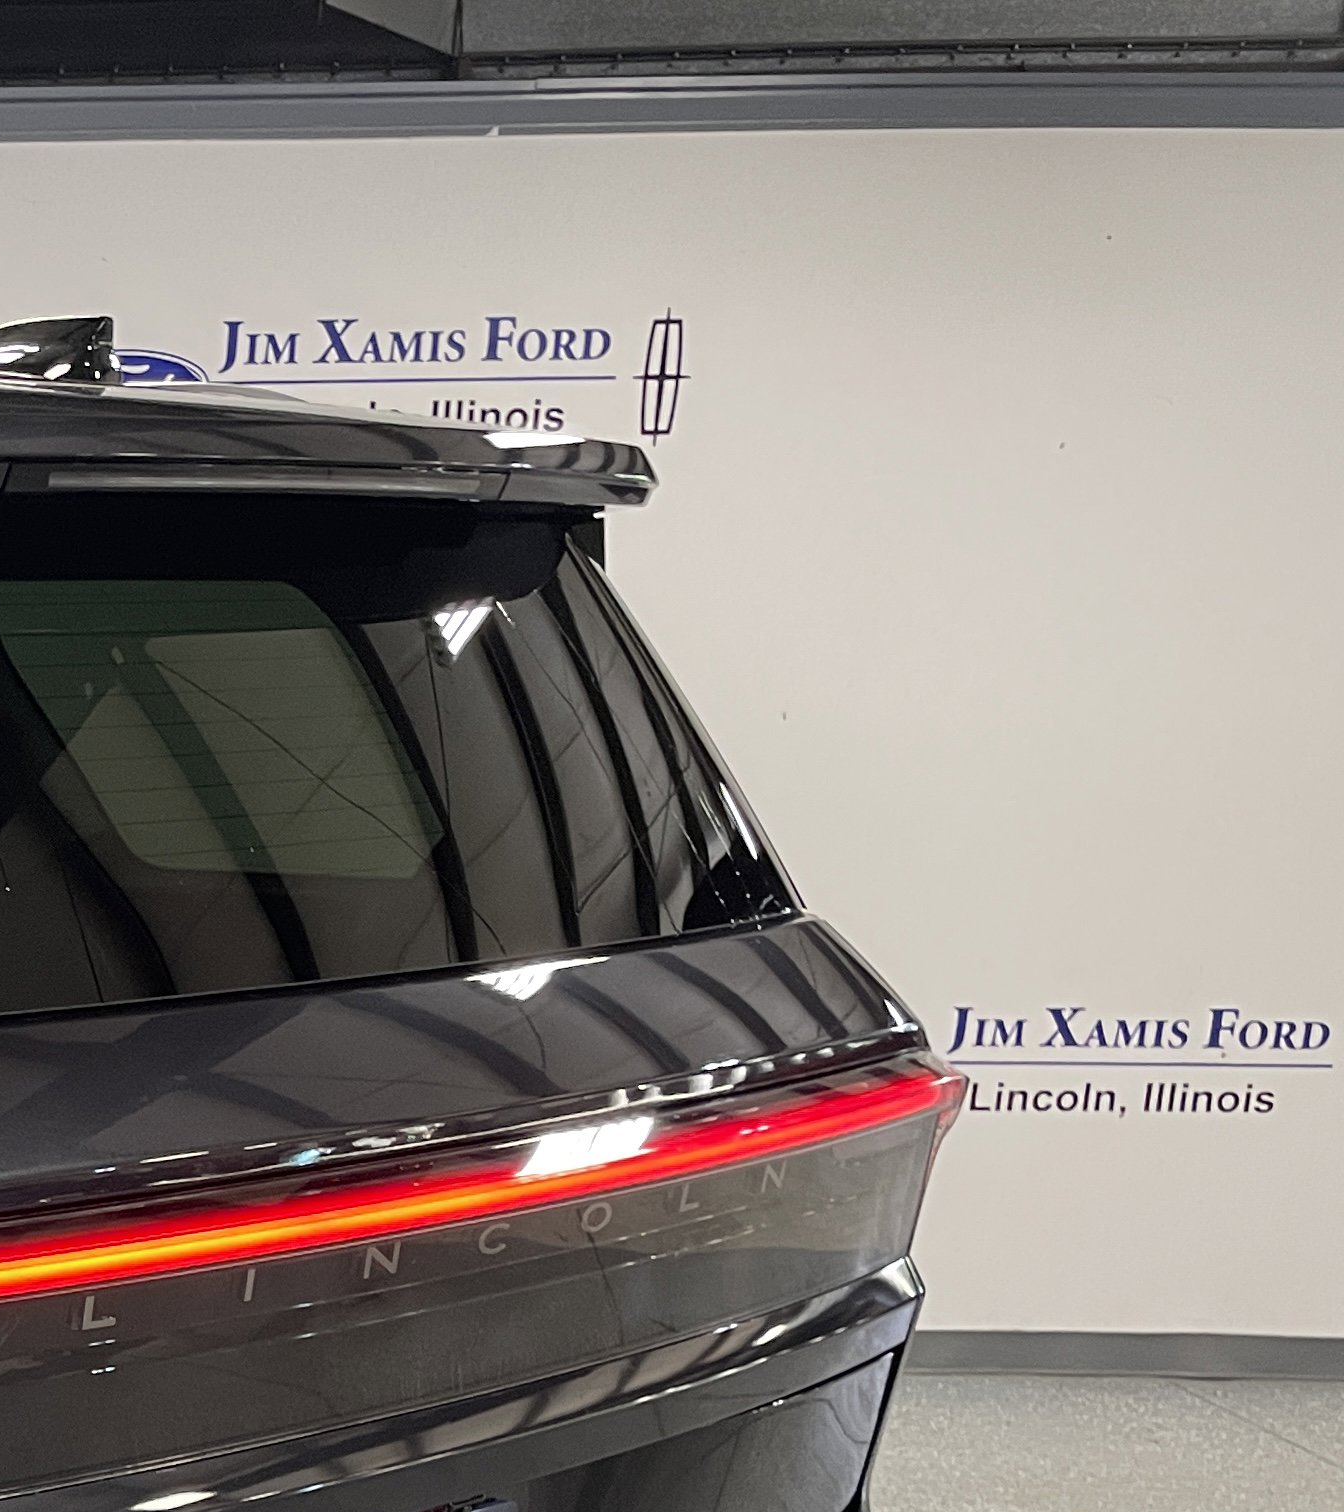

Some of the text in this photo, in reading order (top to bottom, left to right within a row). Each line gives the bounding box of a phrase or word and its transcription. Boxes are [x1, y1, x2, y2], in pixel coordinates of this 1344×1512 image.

[219, 316, 611, 373] JIM XAMIS FORD
[947, 1005, 1332, 1054] JIM XAMIS FORD
[968, 1081, 1276, 1118] Lincoln, Illinois
[80, 1159, 790, 1332] LINCOLN
